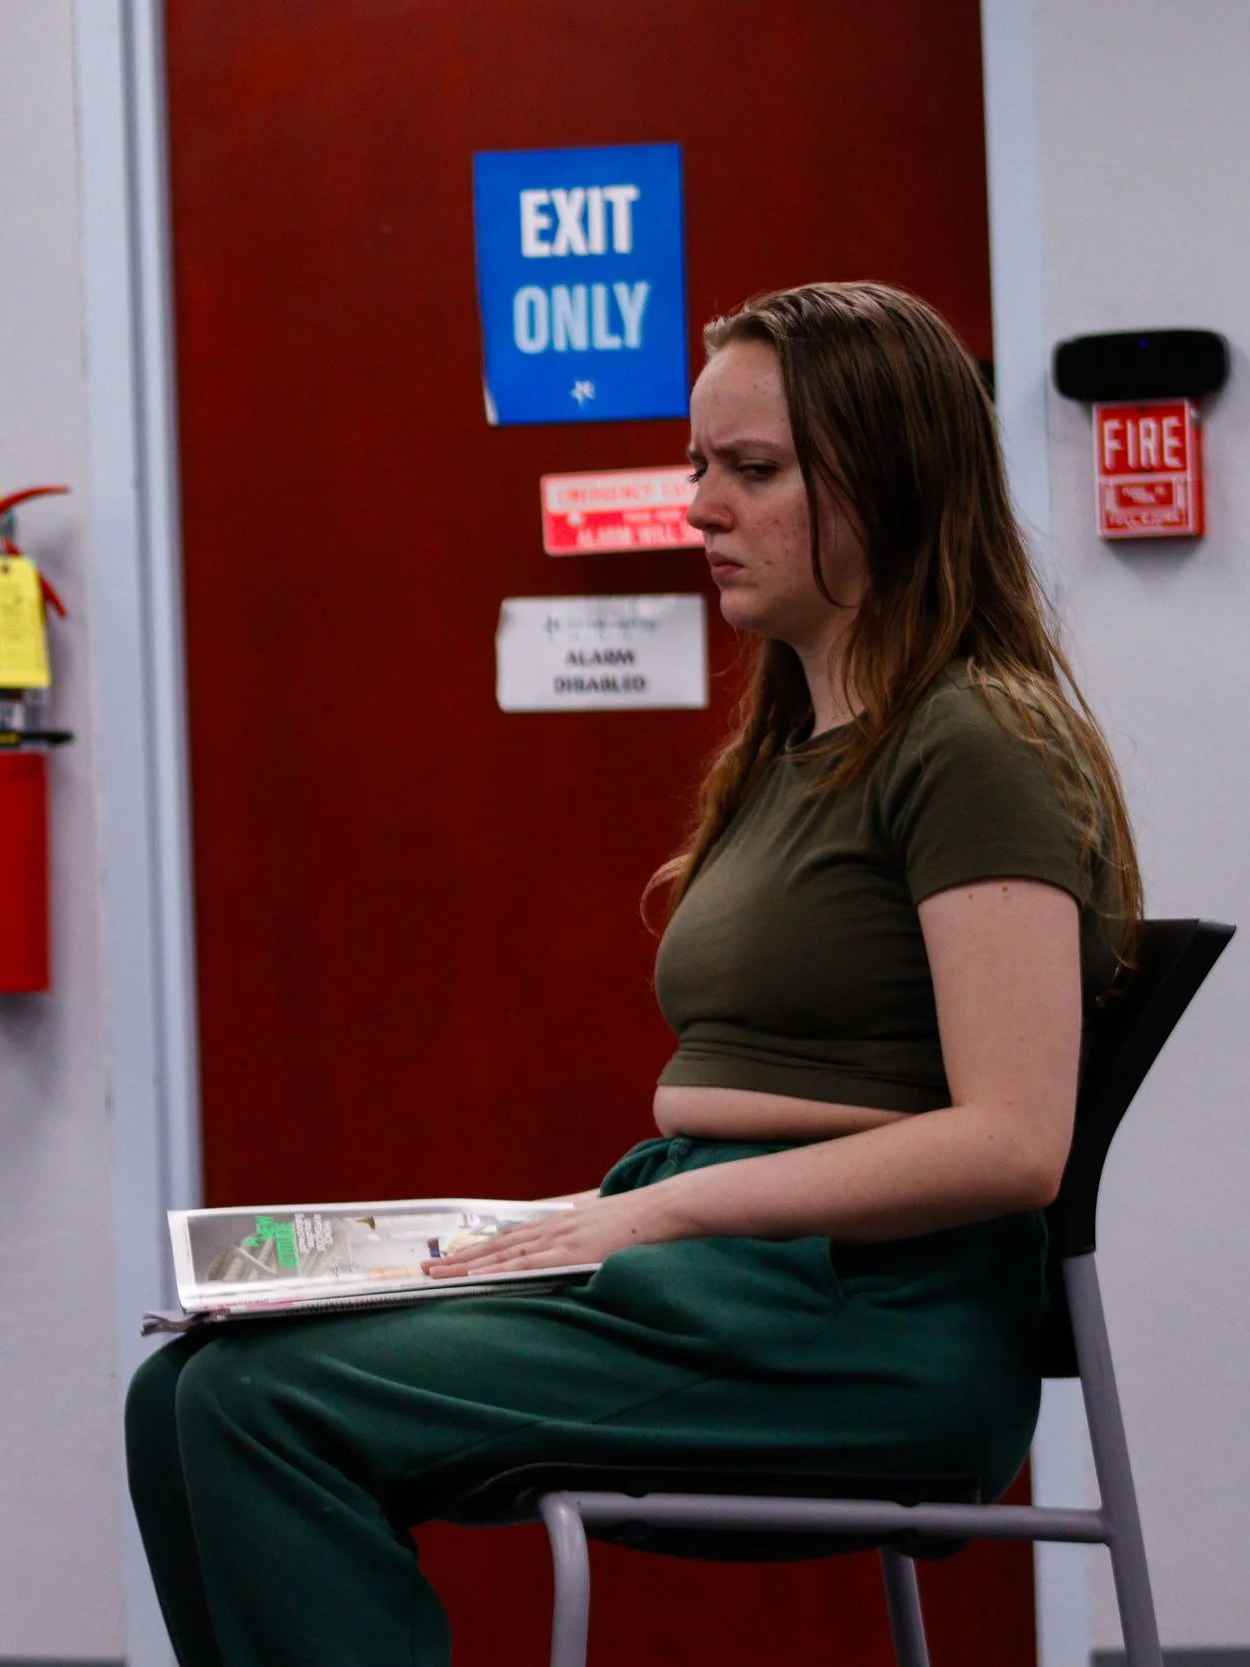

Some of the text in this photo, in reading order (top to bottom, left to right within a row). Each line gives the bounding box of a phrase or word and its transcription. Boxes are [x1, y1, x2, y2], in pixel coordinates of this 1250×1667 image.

[519, 184, 639, 258] EXIT
[512, 281, 650, 355] ONLY
[1102, 416, 1182, 470] FIRE
[553, 674, 646, 693] DISABLED
[565, 648, 635, 667] ALARM
